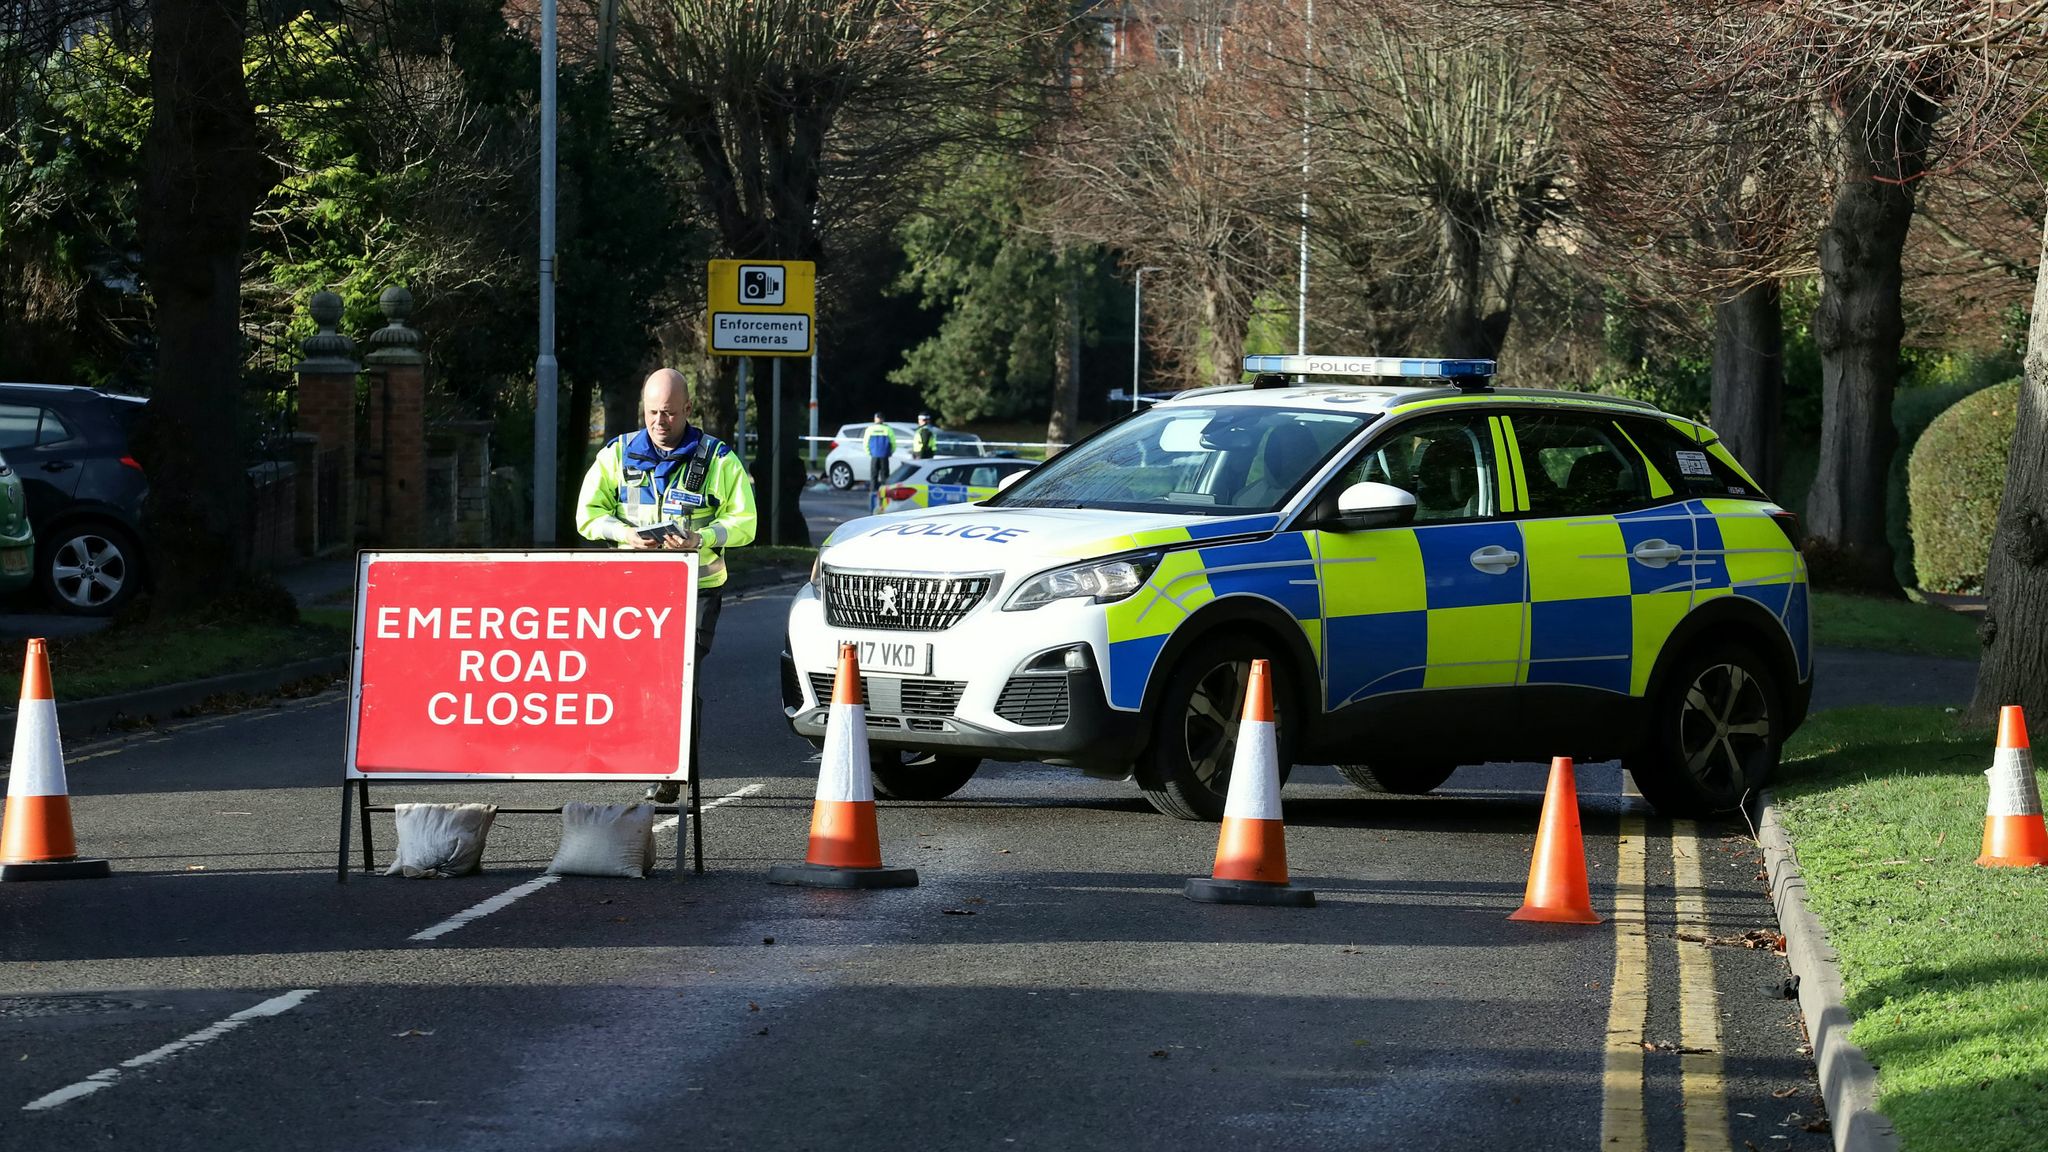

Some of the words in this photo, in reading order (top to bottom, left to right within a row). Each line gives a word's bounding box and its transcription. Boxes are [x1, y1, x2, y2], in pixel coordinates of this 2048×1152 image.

[720, 319, 803, 331] Enforcement
[734, 335, 788, 344] cameras
[1309, 362, 1371, 373] POLICE
[870, 523, 1029, 544] POLICE
[377, 606, 672, 640] EMERGENCY
[837, 640, 876, 664] 17
[881, 642, 915, 667] VKD
[459, 649, 587, 683] ROAD
[427, 691, 614, 726] CLOSED
